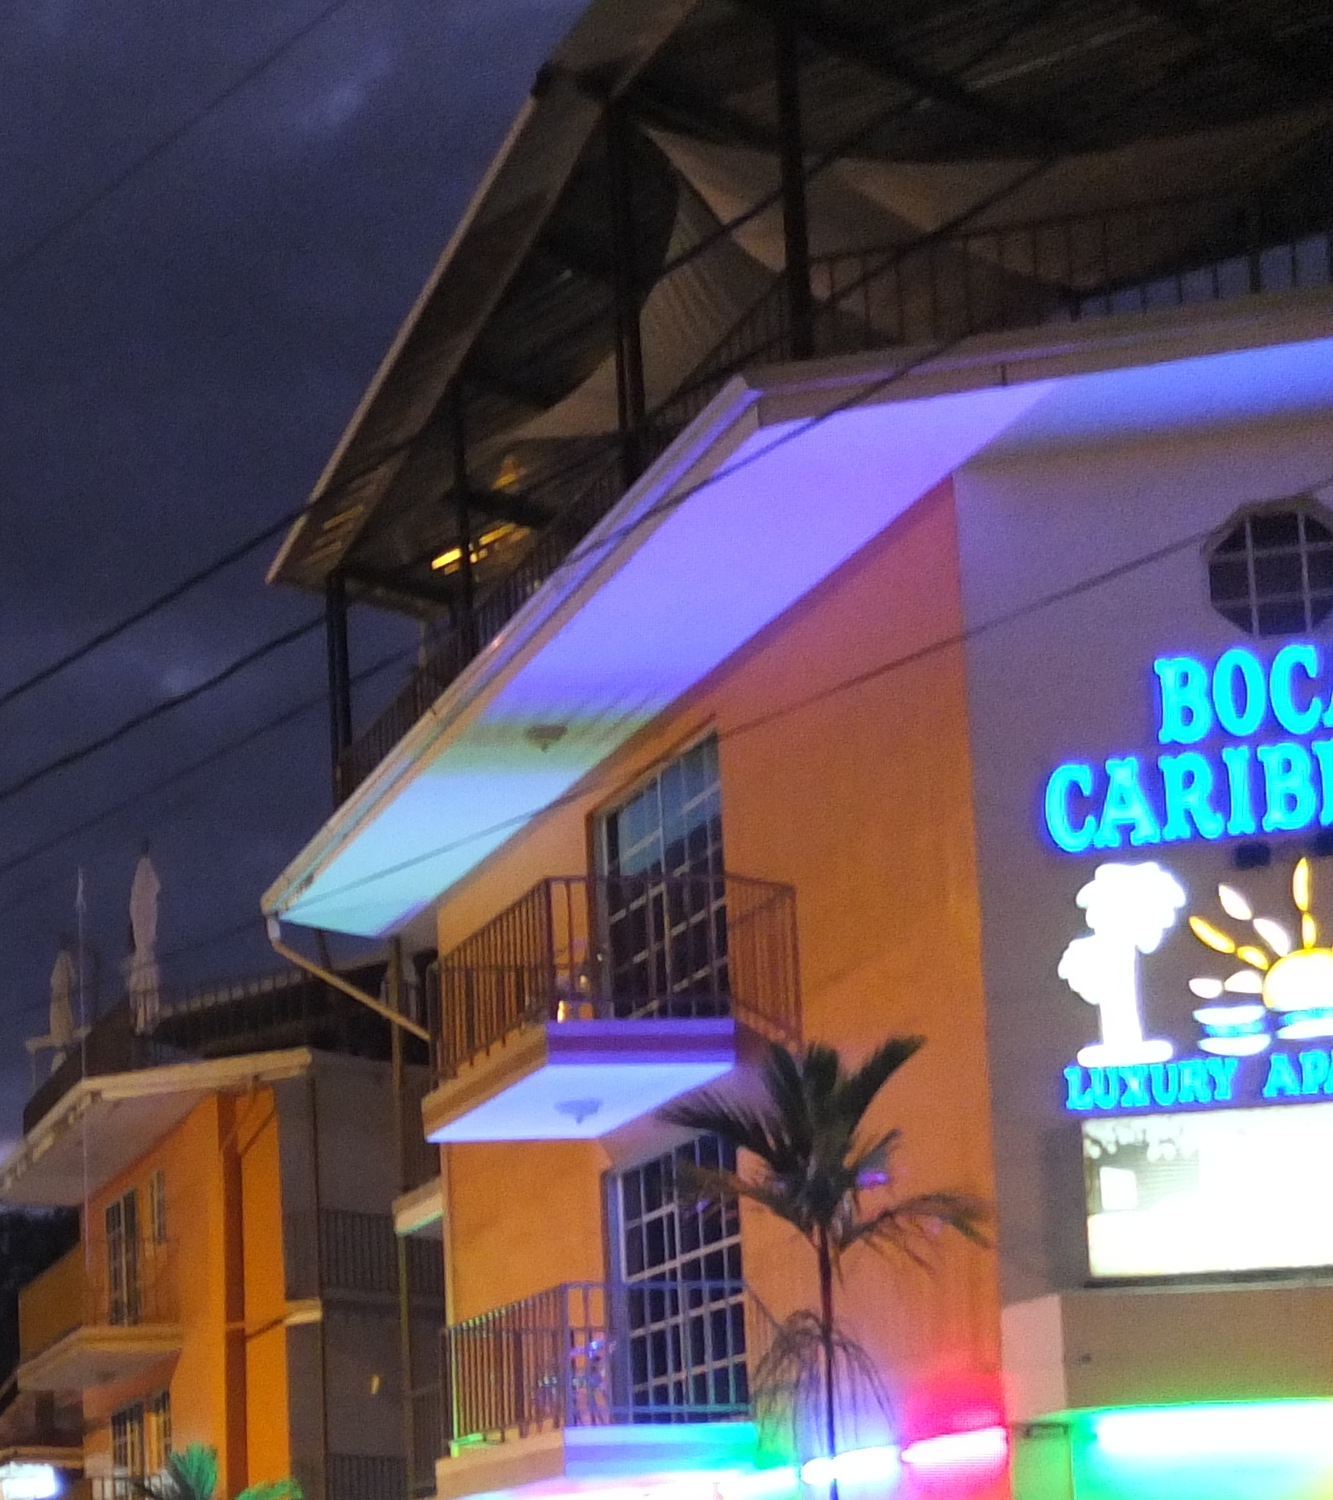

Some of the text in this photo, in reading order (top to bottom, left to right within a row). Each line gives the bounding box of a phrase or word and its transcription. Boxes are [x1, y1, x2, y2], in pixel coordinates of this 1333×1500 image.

[1153, 644, 1333, 744] BOC
[1064, 1049, 1333, 1111] LUXURY AP
